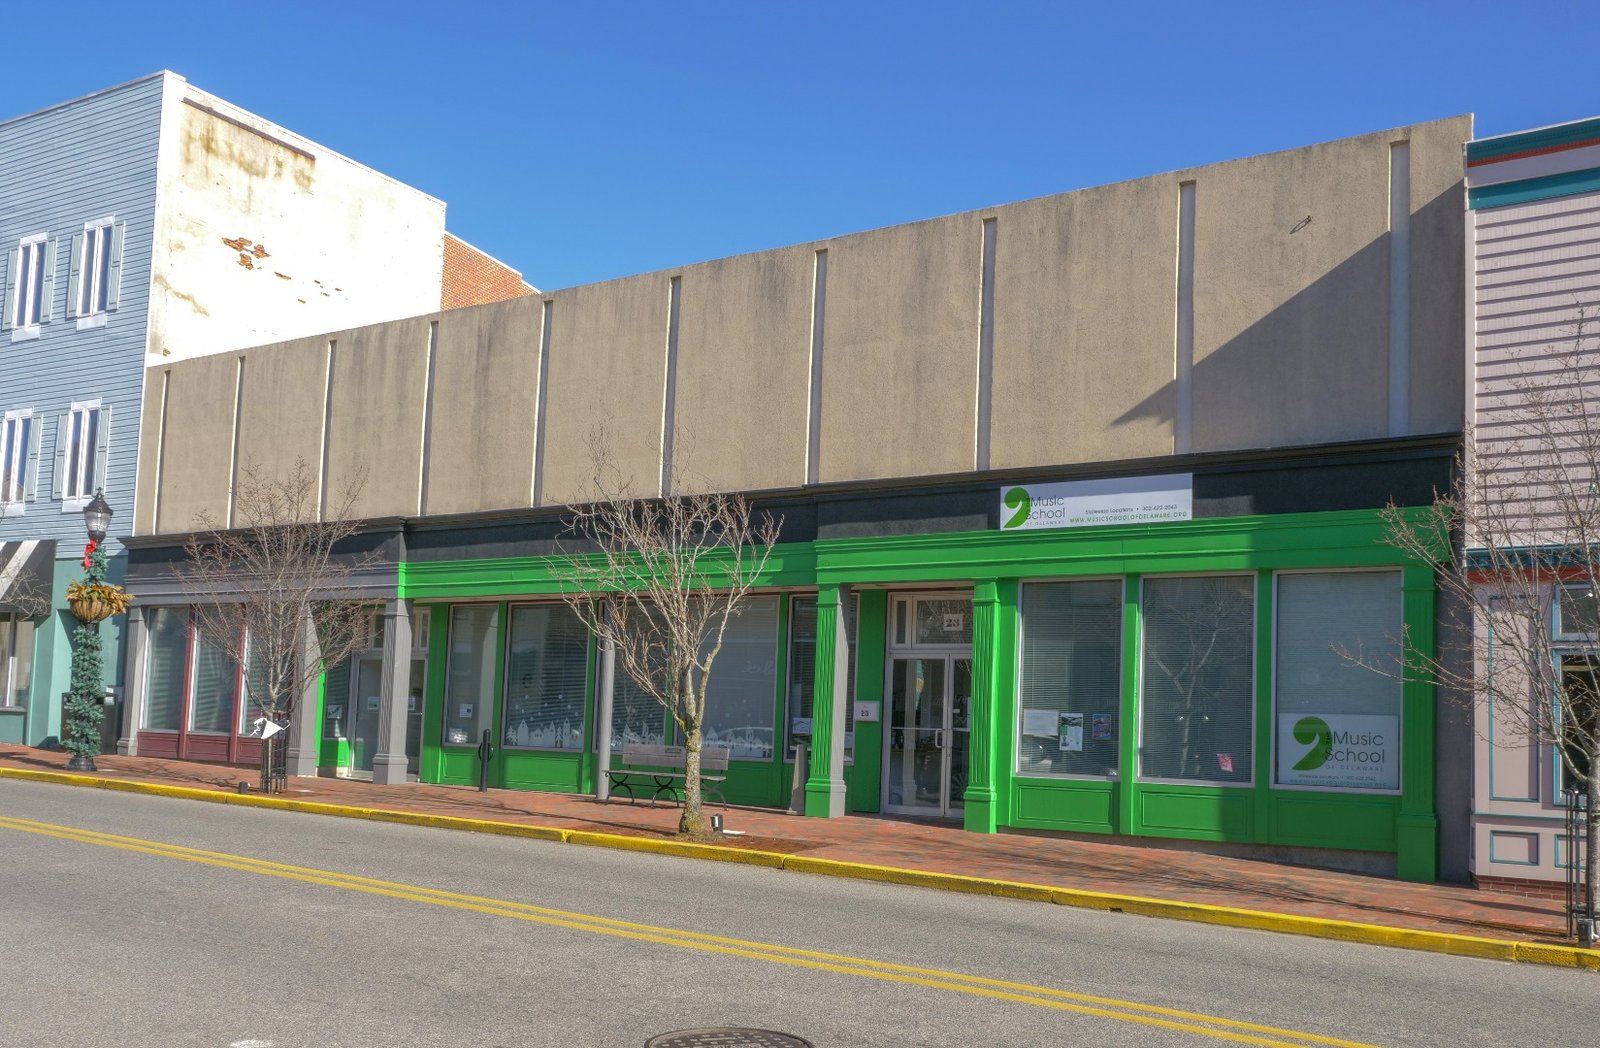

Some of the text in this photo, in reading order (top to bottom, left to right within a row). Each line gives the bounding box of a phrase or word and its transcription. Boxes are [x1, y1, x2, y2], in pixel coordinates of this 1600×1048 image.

[1031, 496, 1064, 507] Music
[1025, 508, 1065, 520] School
[1333, 731, 1384, 746] Music
[1325, 747, 1385, 763] School
